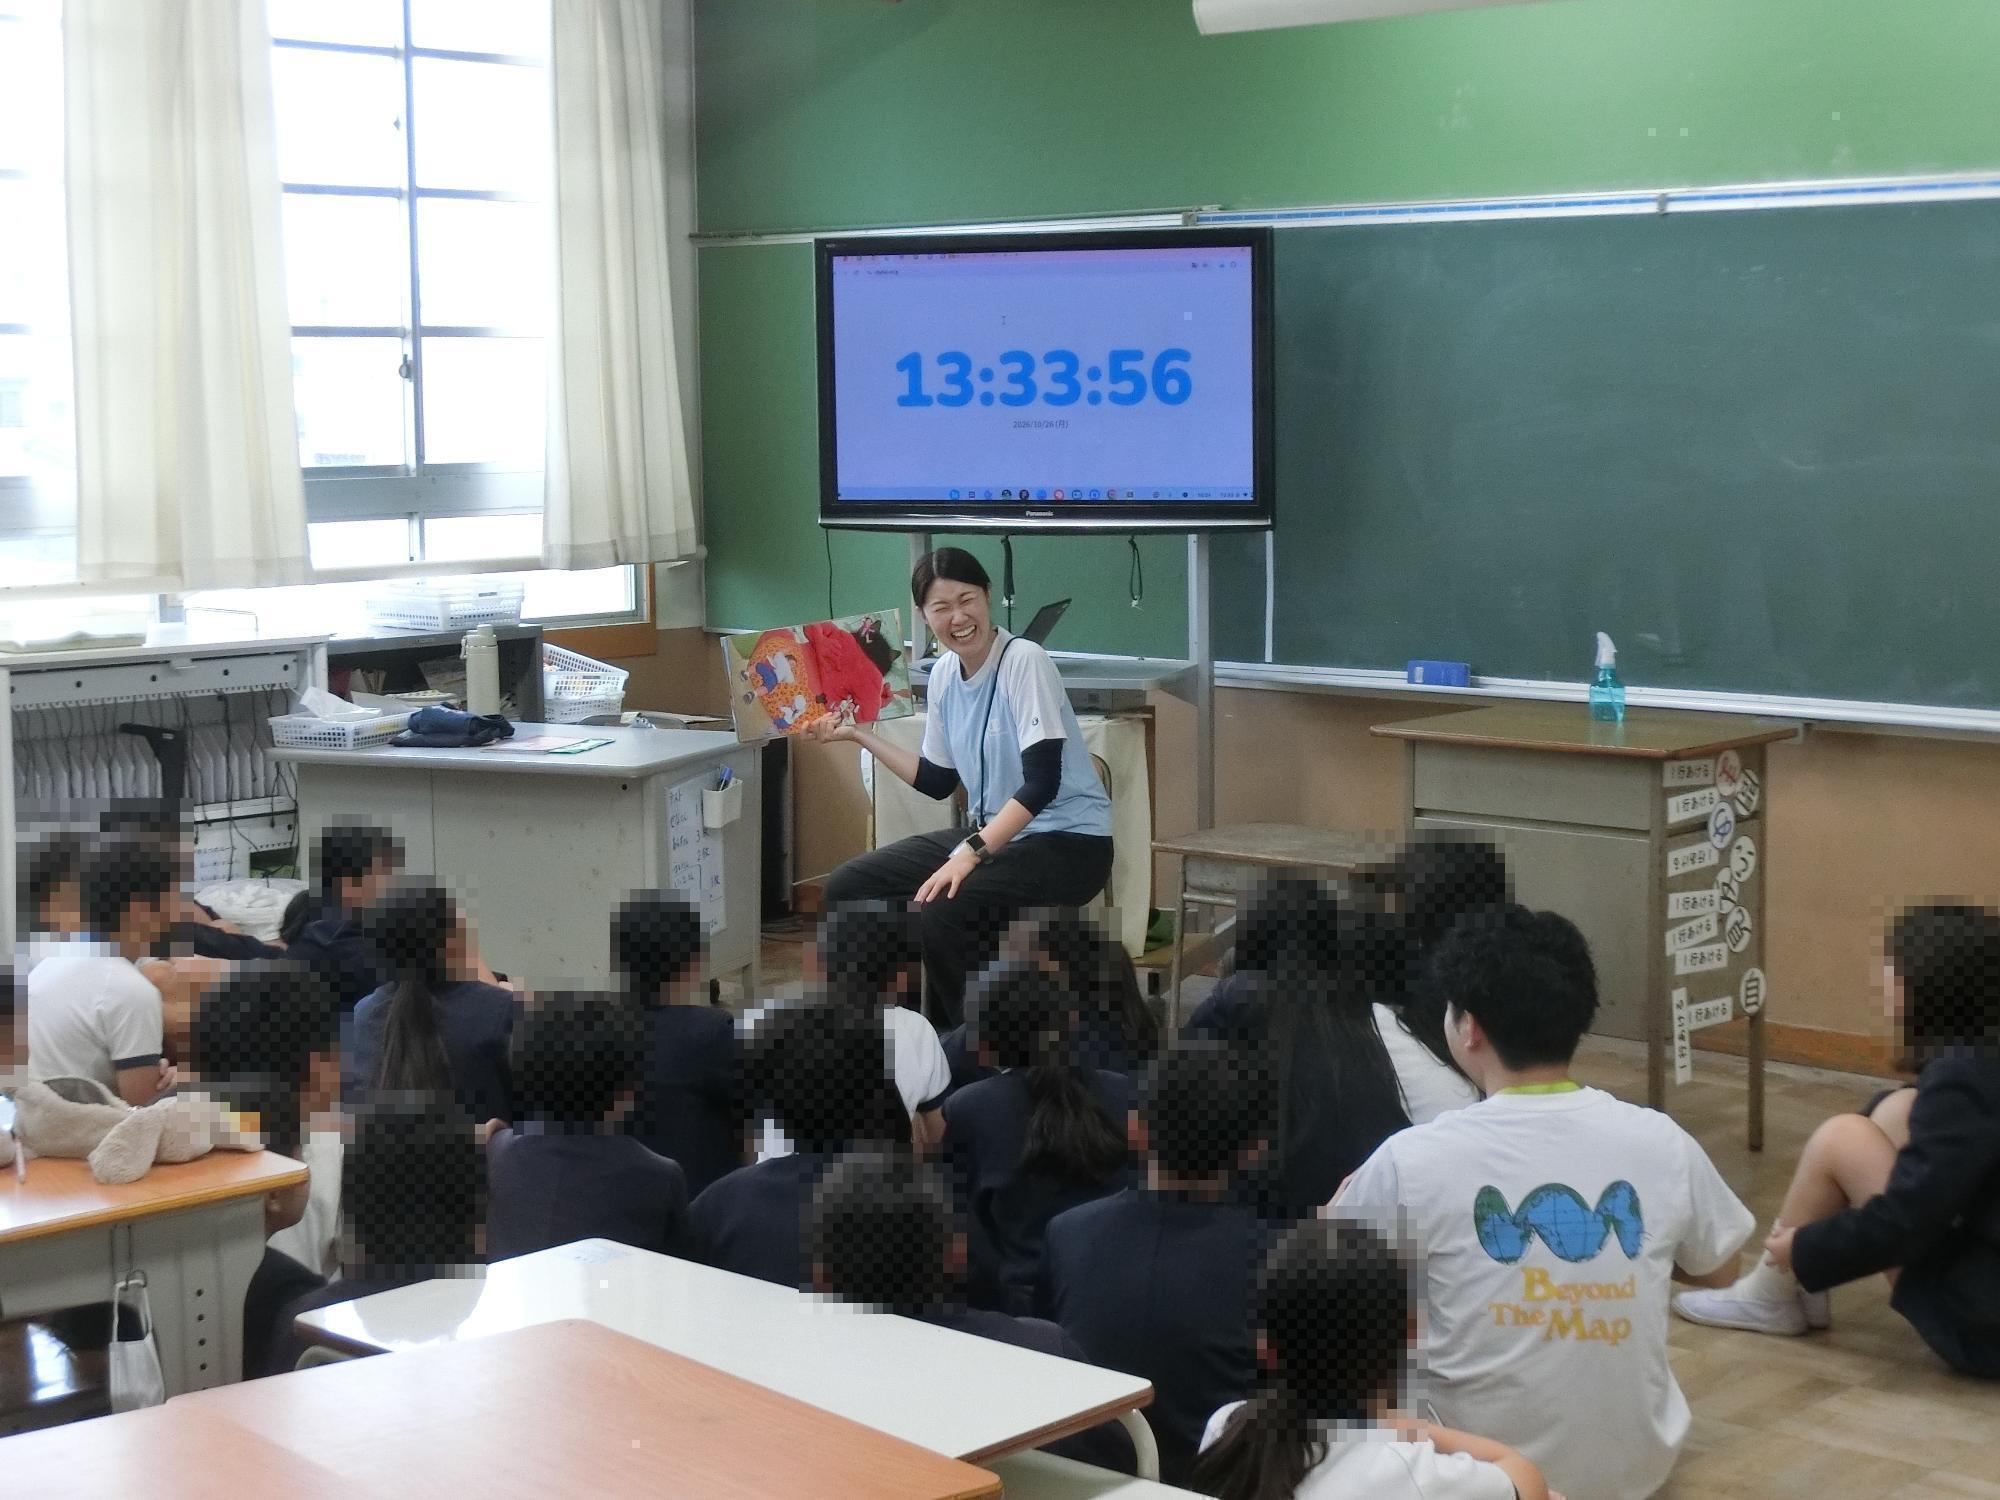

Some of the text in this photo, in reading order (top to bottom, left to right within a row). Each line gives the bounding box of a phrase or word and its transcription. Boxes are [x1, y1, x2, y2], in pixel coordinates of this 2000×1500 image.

[895, 348, 1193, 408] 13:33:56
[1520, 1266, 1636, 1306] Beyond
[1488, 1301, 1633, 1346] The Map
